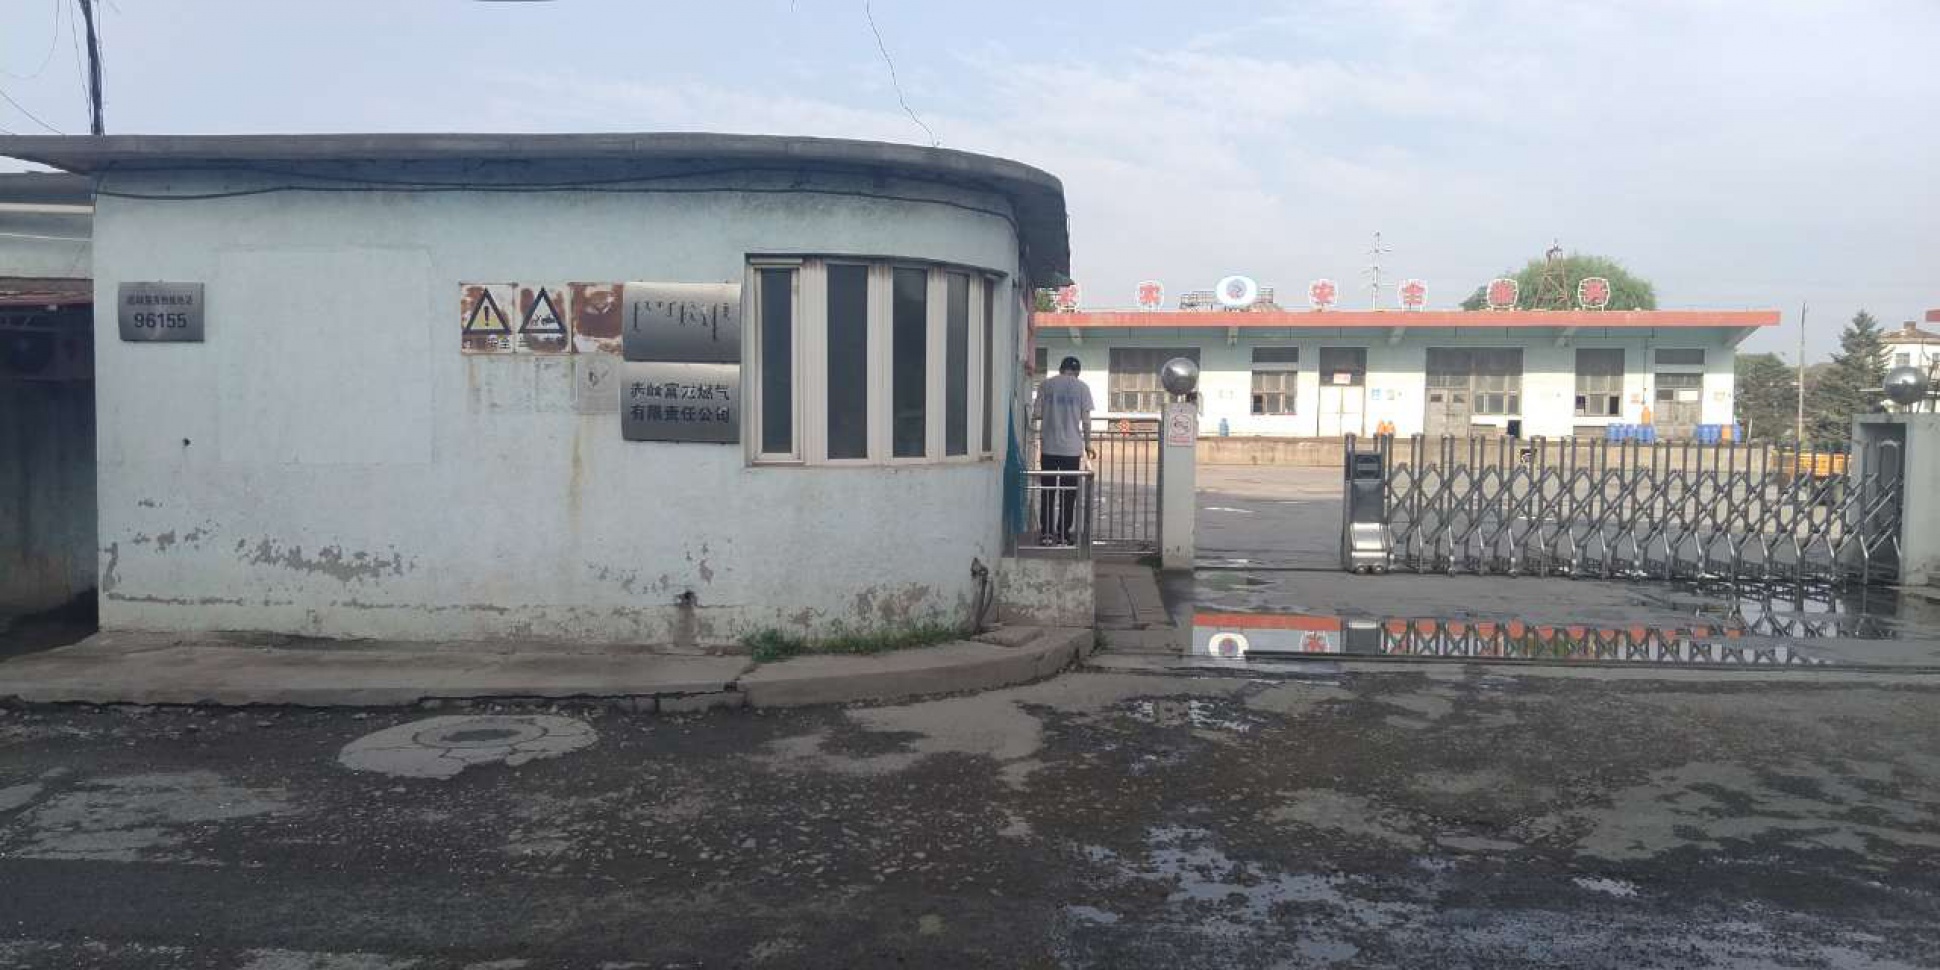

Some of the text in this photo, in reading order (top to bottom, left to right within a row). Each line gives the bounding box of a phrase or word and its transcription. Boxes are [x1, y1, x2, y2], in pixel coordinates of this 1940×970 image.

[134, 313, 187, 328] 96155
[630, 404, 730, 424] 有限责任公司
